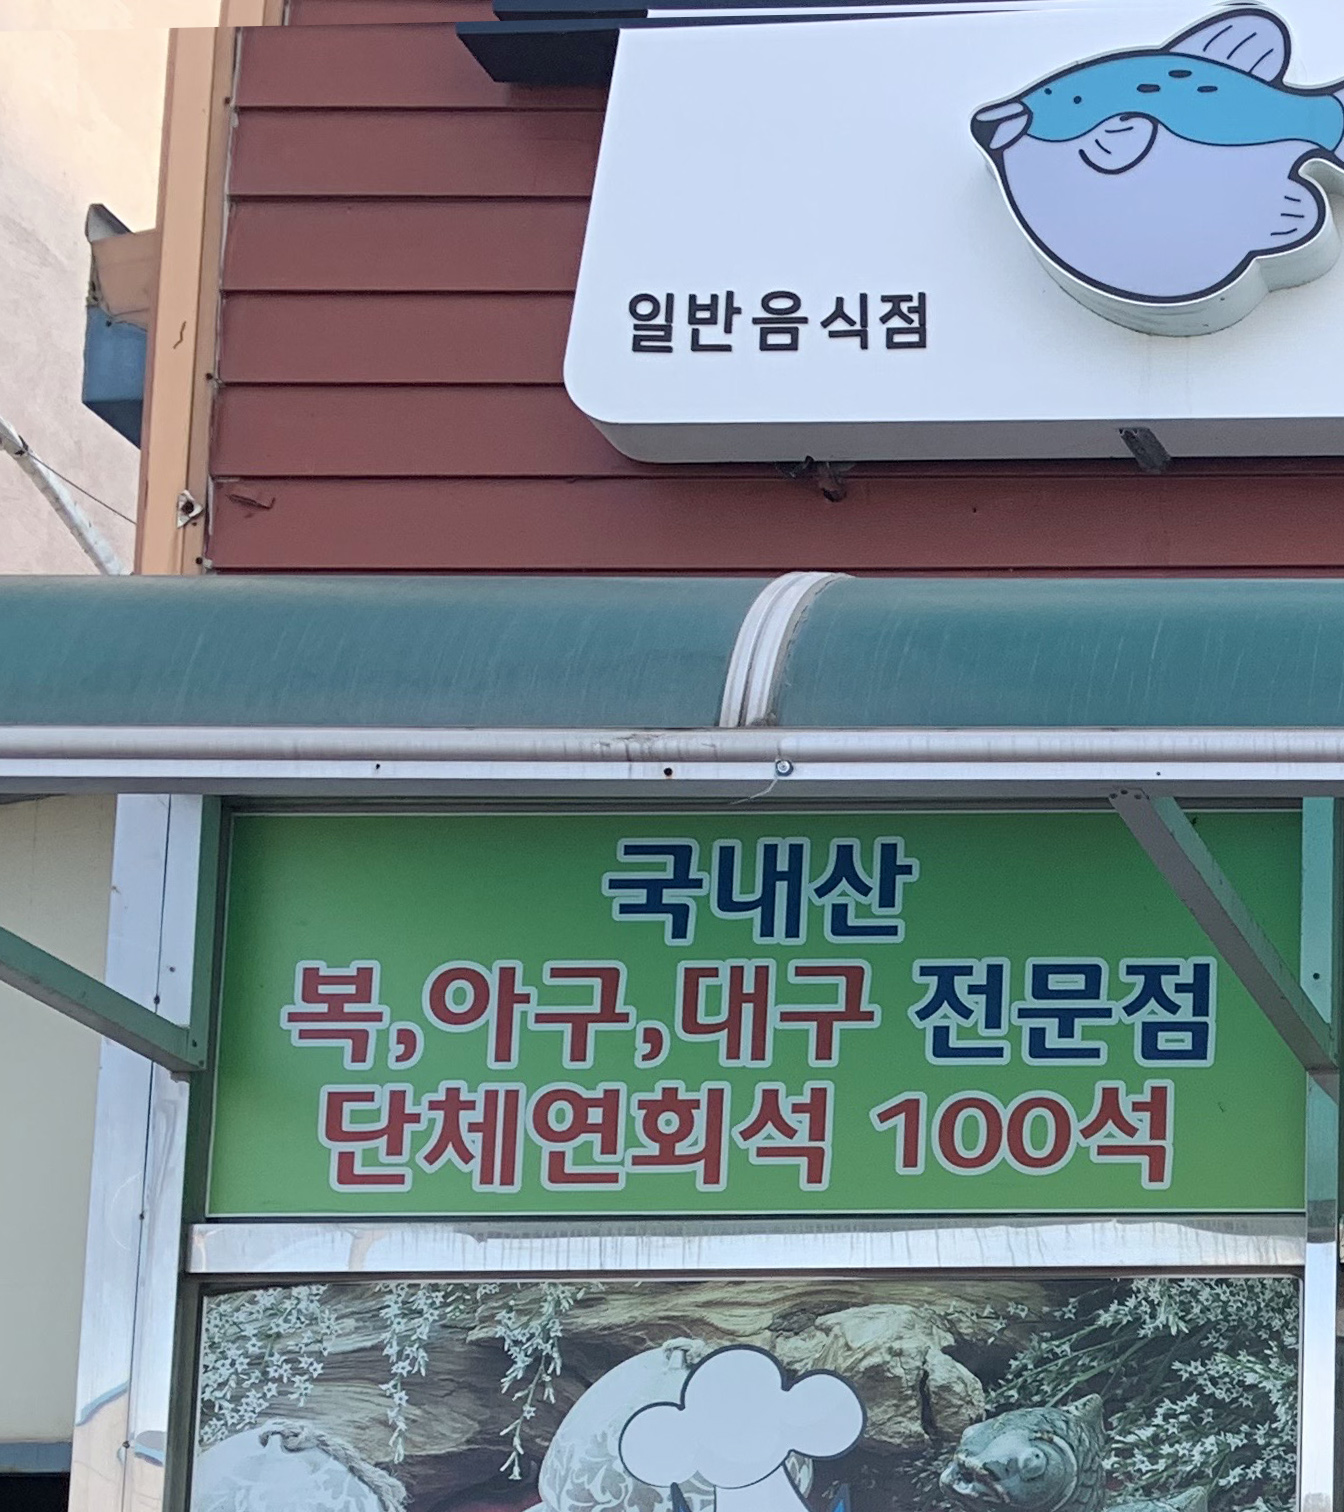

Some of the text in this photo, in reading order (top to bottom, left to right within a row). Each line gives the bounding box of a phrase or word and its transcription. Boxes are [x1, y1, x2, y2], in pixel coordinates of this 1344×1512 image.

[627, 290, 928, 352] 일반음식점
[604, 838, 919, 943] 국내산
[911, 956, 1217, 1066] 전문점
[318, 1081, 1177, 1191] 단체연회석 100석
